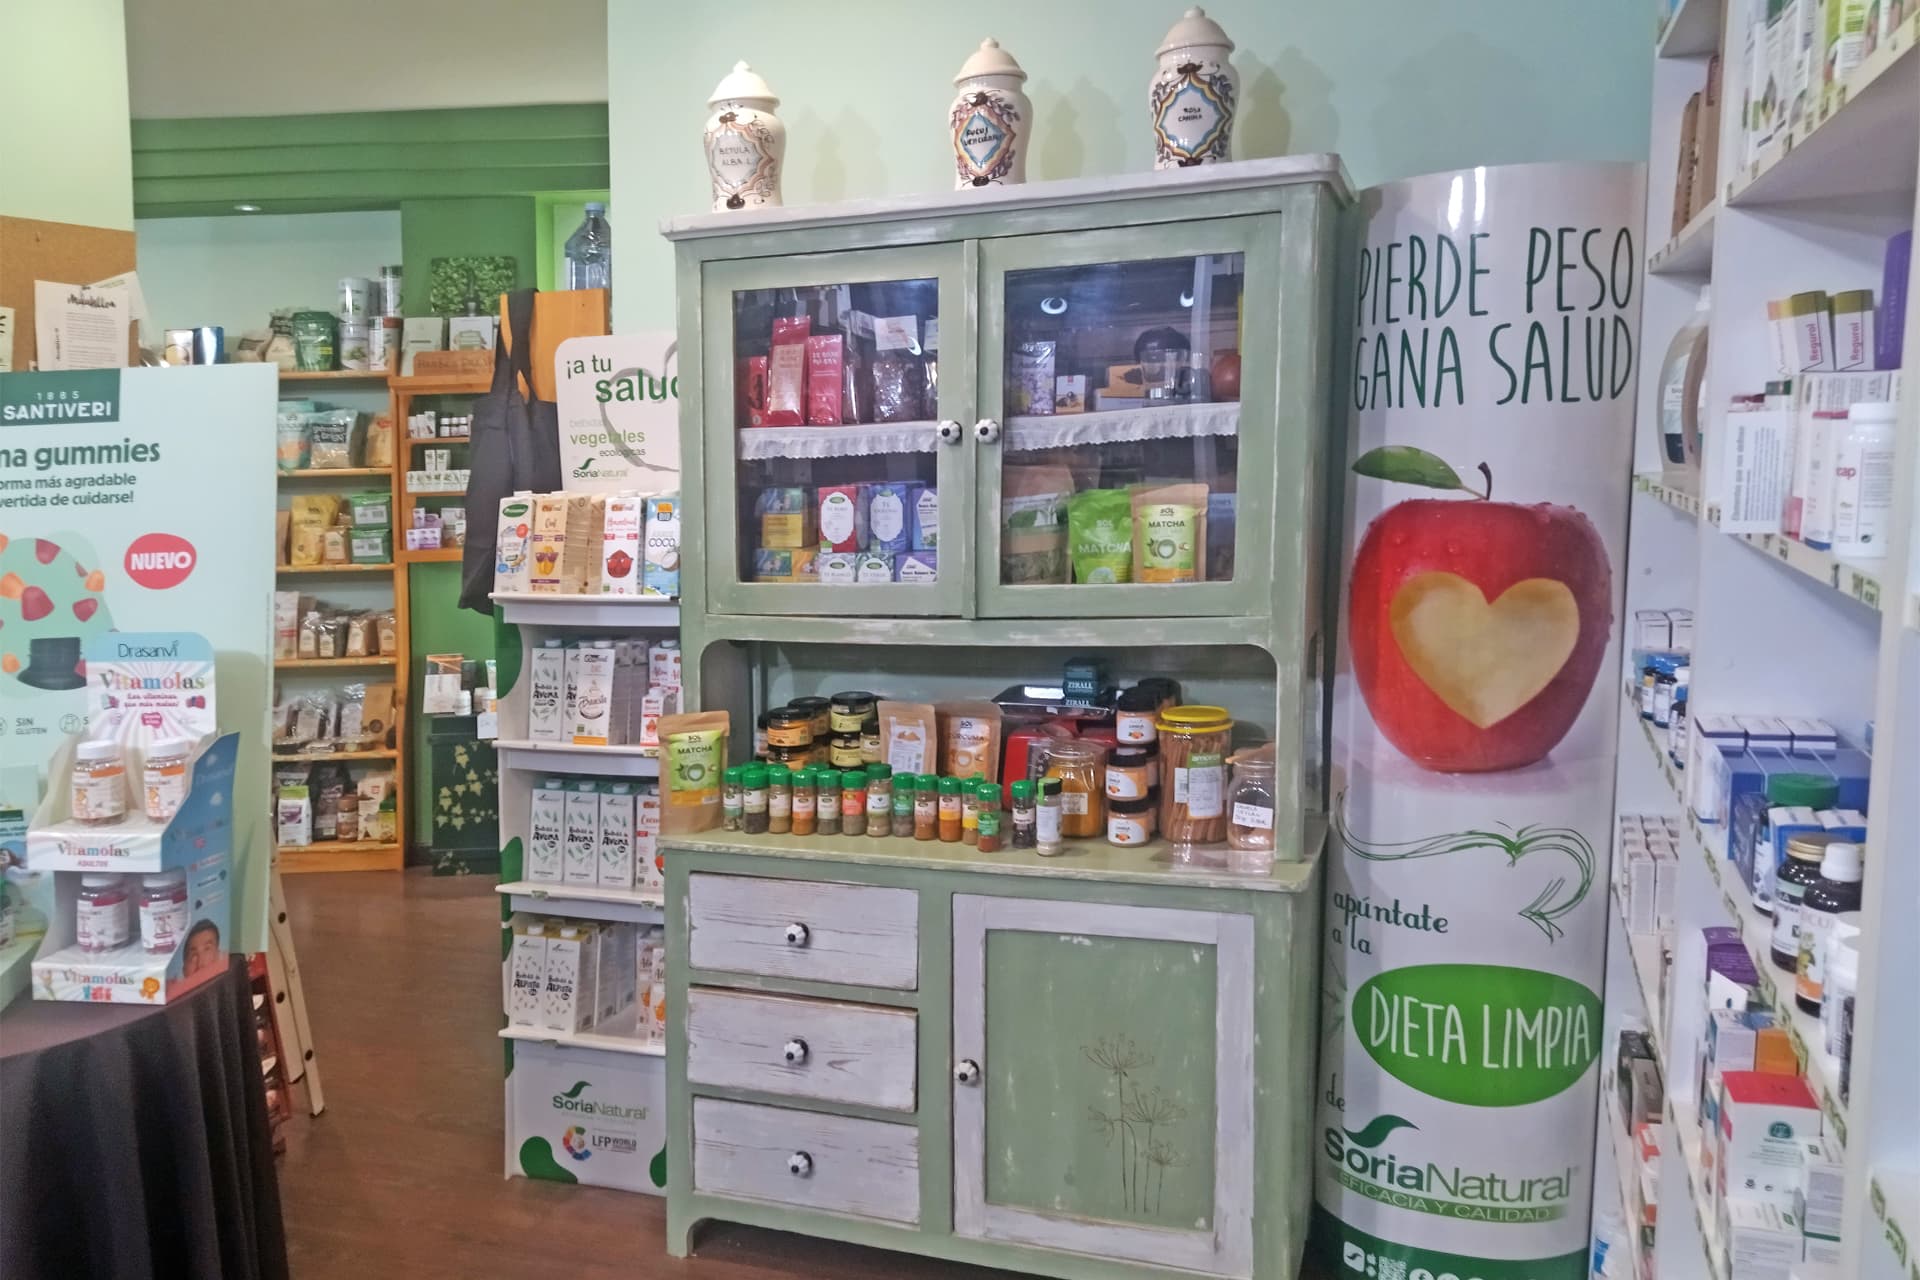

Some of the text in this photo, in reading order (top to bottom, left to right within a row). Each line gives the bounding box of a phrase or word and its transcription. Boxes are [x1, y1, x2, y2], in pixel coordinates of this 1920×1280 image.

[1357, 227, 1633, 327] PIERDE PESO
[592, 354, 612, 373] tu
[1354, 315, 1632, 411] GANA SALUD
[3, 401, 112, 420] SANTIVERI
[570, 429, 646, 448] vegetales
[34, 437, 161, 471] gummies
[64, 472, 137, 490] agradable
[50, 494, 69, 506] de
[72, 490, 134, 505] cuidarse!
[1148, 520, 1186, 529] MATCHA
[1077, 541, 1132, 554] MATCHA
[130, 551, 192, 571] NUEVO
[99, 670, 207, 690] Vitamolas
[677, 745, 713, 755] MATCHA
[57, 840, 130, 857] Vitamolas
[1333, 893, 1449, 933] apúntate
[1332, 915, 1372, 955] a la
[63, 968, 135, 985] Vitamolas
[1370, 985, 1591, 1069] DIETA LIMPIA
[1326, 1073, 1345, 1112] de
[552, 1095, 648, 1120] SoriaNatural
[1325, 1127, 1572, 1203] SoriaNatural
[1341, 1172, 1550, 1222] EFICACIA Y CALIDAD
